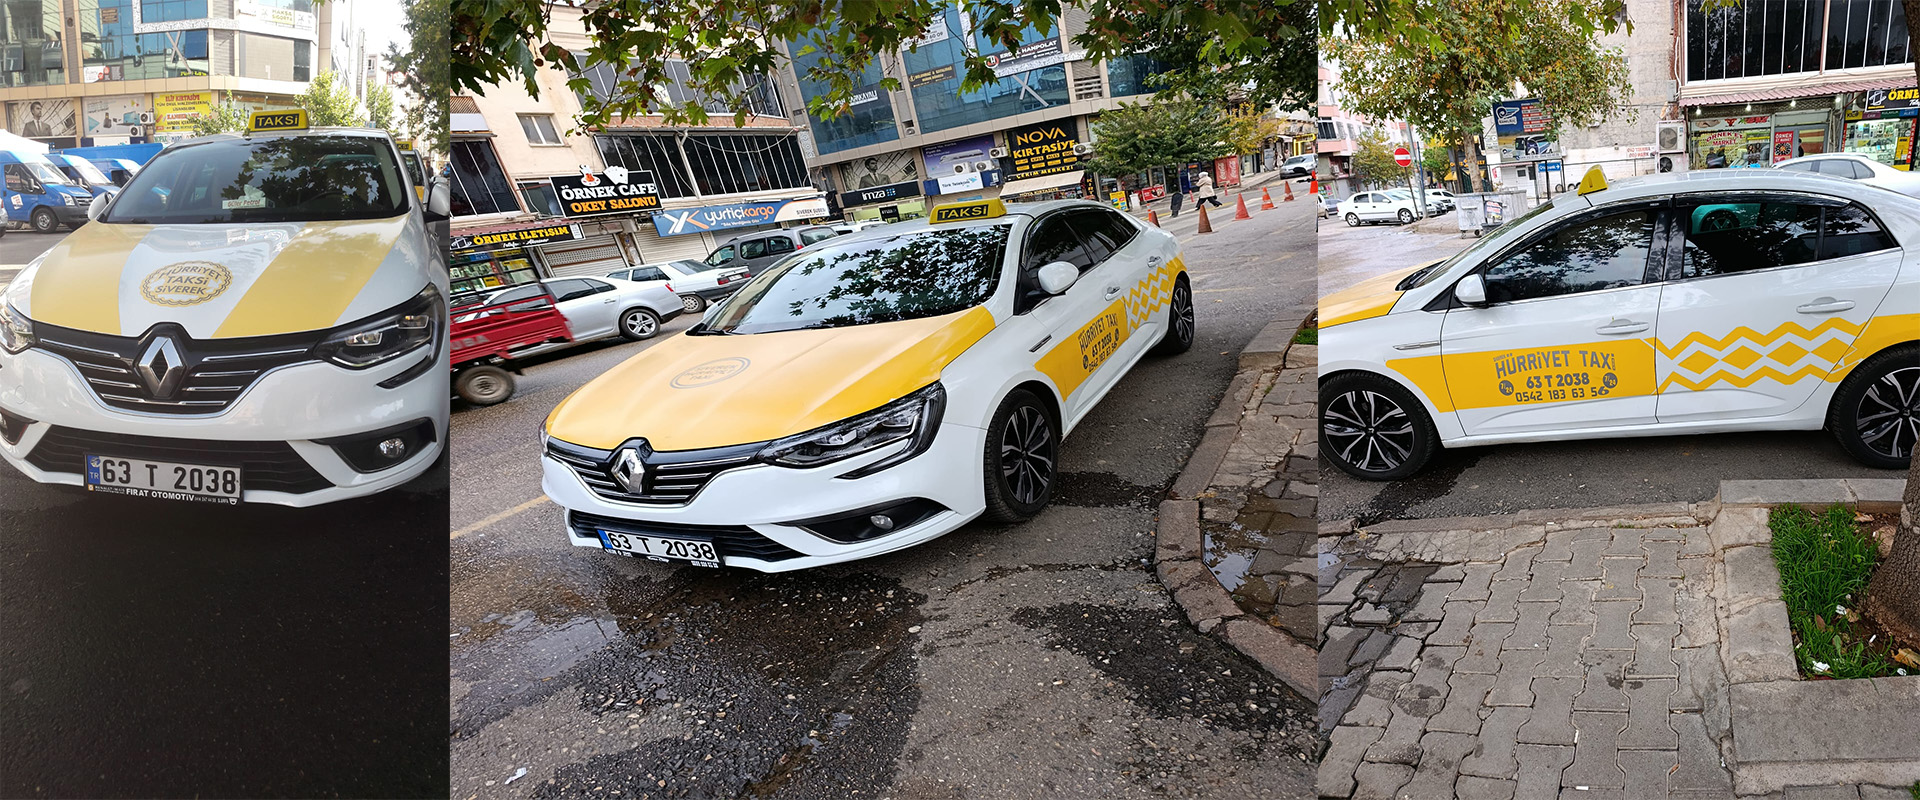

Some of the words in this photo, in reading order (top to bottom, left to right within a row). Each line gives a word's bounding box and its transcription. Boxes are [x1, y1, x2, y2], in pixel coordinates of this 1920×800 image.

[1016, 126, 1066, 146] NOVA
[1013, 140, 1075, 158] KIRTASİYE
[561, 184, 618, 200] ÖRNEK
[618, 183, 657, 196] CAFE
[570, 200, 607, 213] OKEY
[609, 196, 656, 210] SALONU
[704, 204, 775, 226] yurtiçikargo
[473, 232, 518, 246] ÖRNEK
[1526, 375, 1542, 389] 63
[1544, 375, 1553, 388] T
[1555, 372, 1590, 386] 2038
[1516, 390, 1543, 402] 0542
[1548, 389, 1566, 400] 183
[1572, 388, 1585, 398] 63
[1591, 386, 1610, 397] 56
[90, 472, 99, 480] TR
[102, 460, 131, 484] 63
[145, 464, 158, 487] T
[173, 466, 236, 494] 2038
[126, 488, 149, 498] FIRAT
[608, 532, 632, 550] 63
[636, 536, 650, 553] T
[661, 540, 716, 560] 2038
